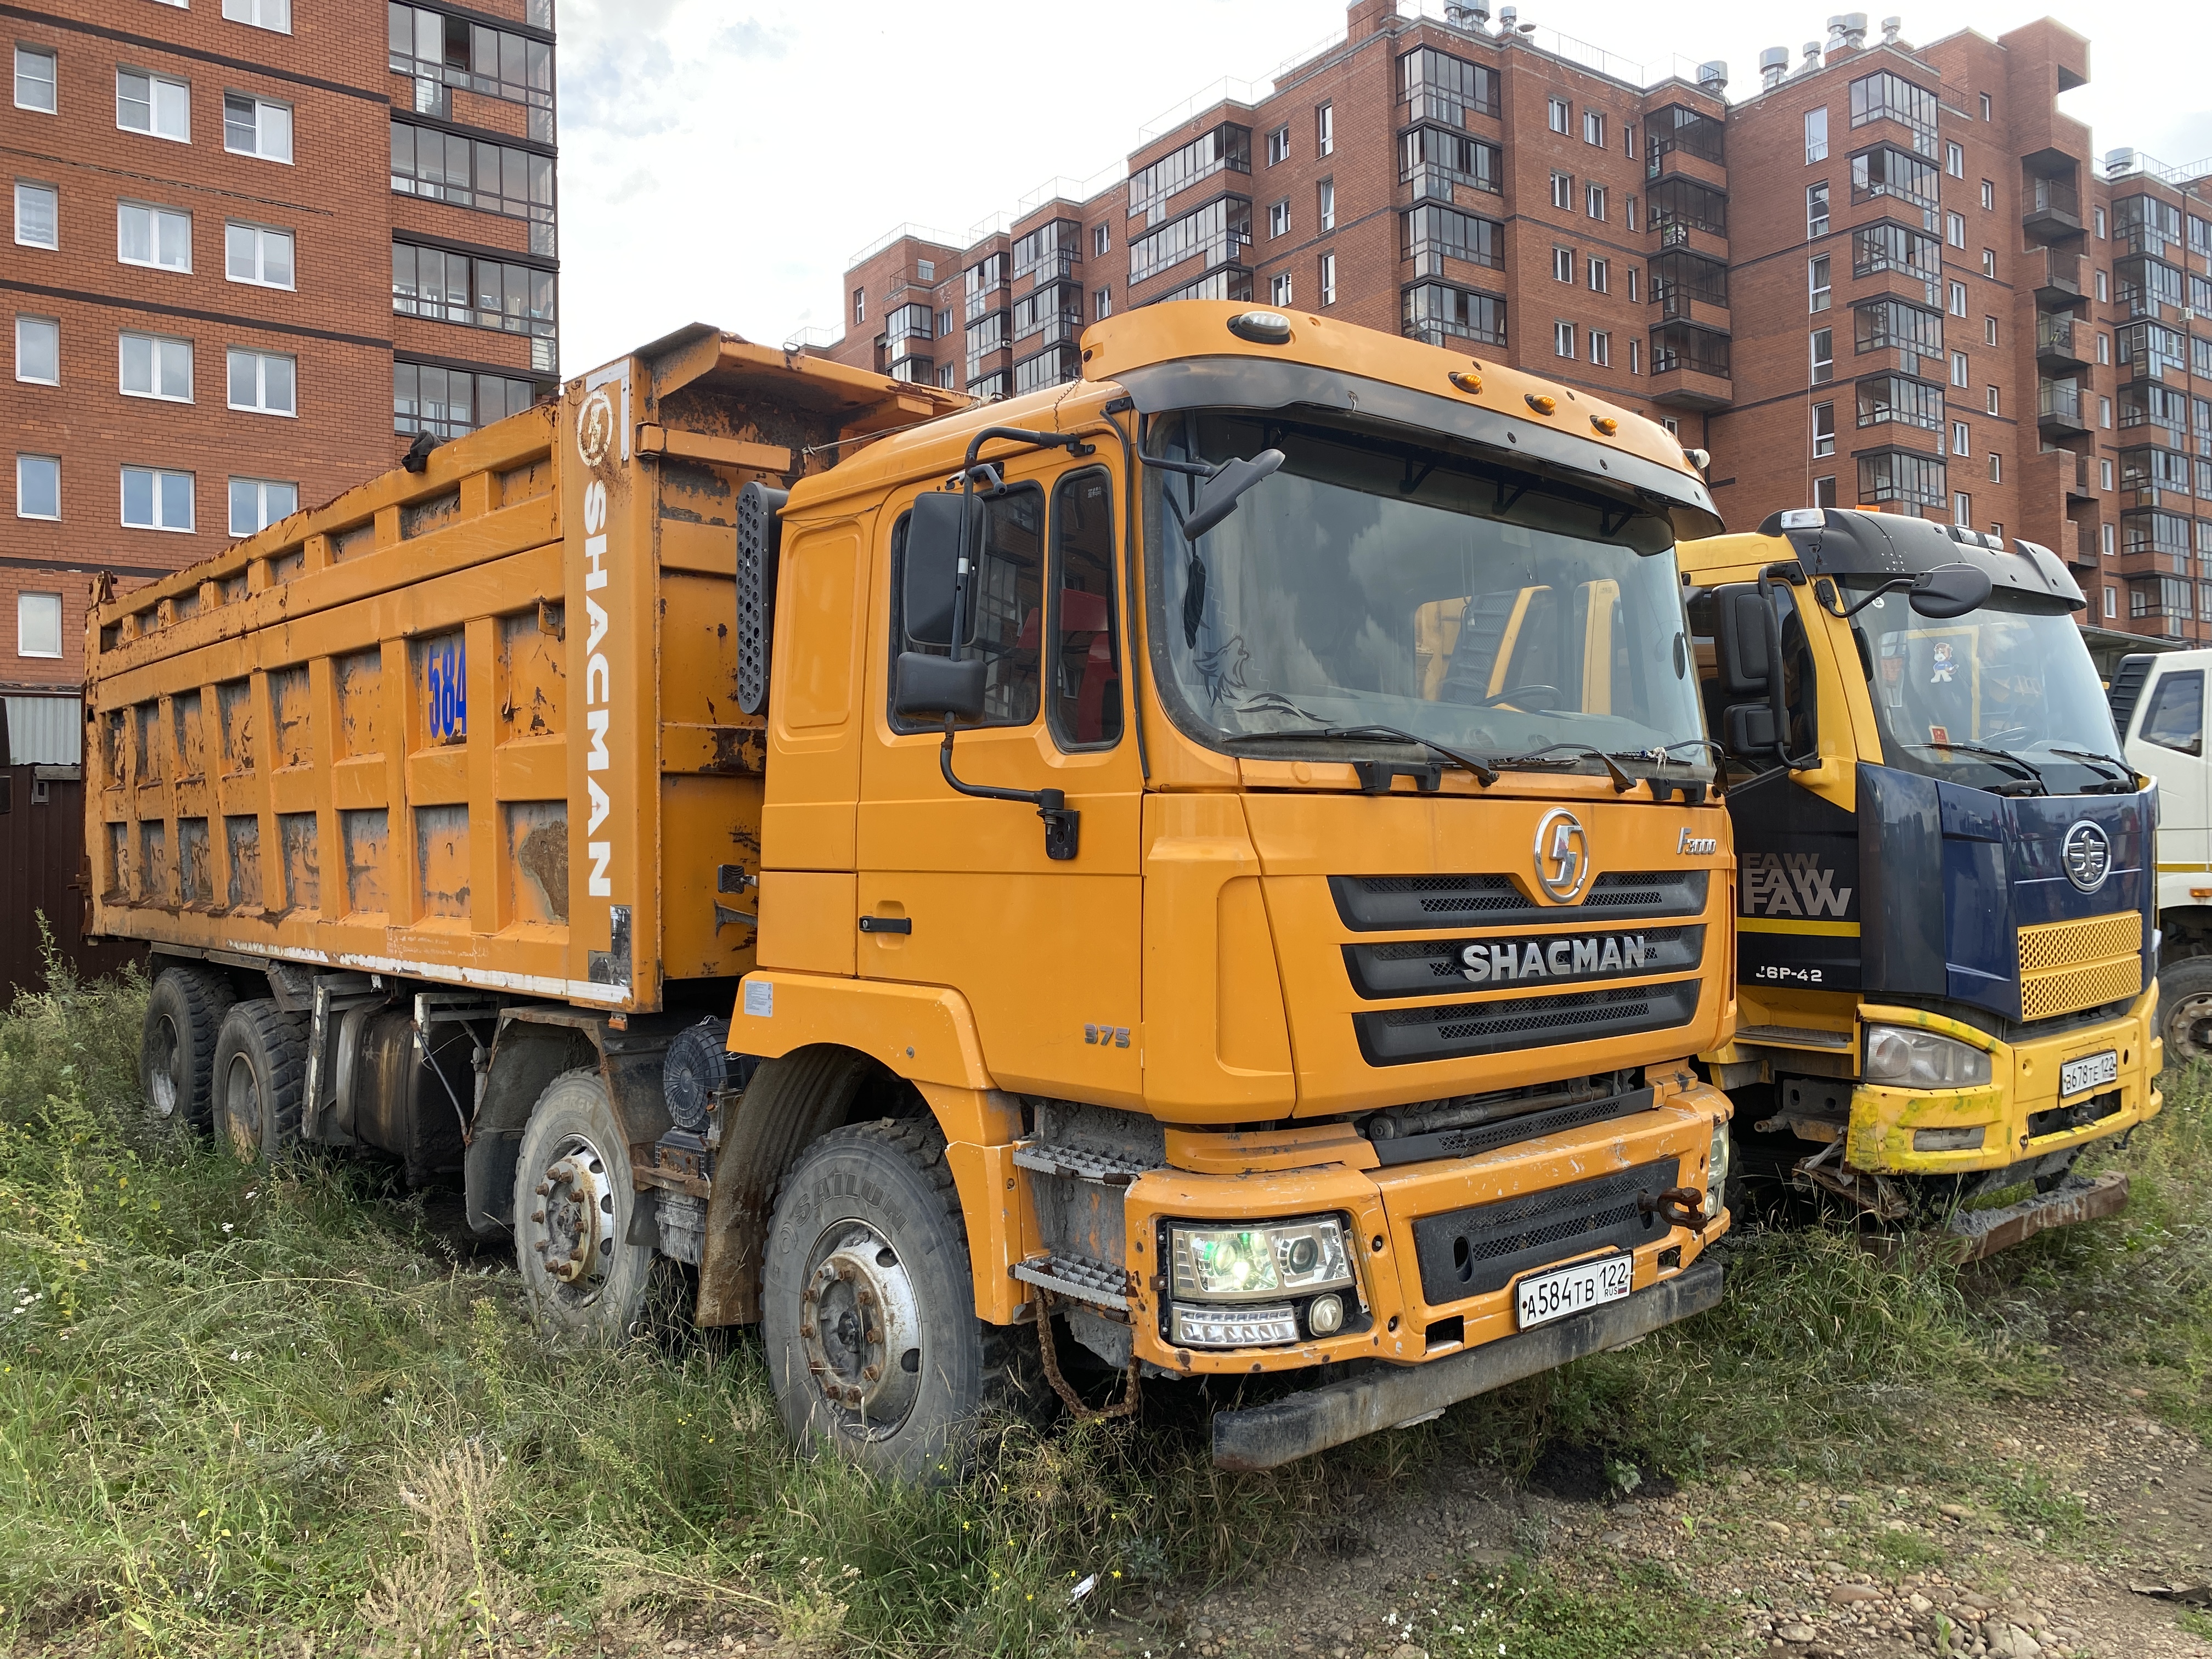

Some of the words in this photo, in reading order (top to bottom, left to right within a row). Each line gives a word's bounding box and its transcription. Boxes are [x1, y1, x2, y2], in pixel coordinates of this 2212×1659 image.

[428, 638, 466, 738] 584
[584, 479, 611, 896] SHACMAN
[1743, 887, 1852, 916] FAW
[1461, 935, 1645, 983] SHACMAN
[1084, 1023, 1130, 1048] 375
[793, 1172, 909, 1234] SAILUN
[1599, 1262, 1626, 1289] 122
[1604, 1286, 1618, 1297] RUS
